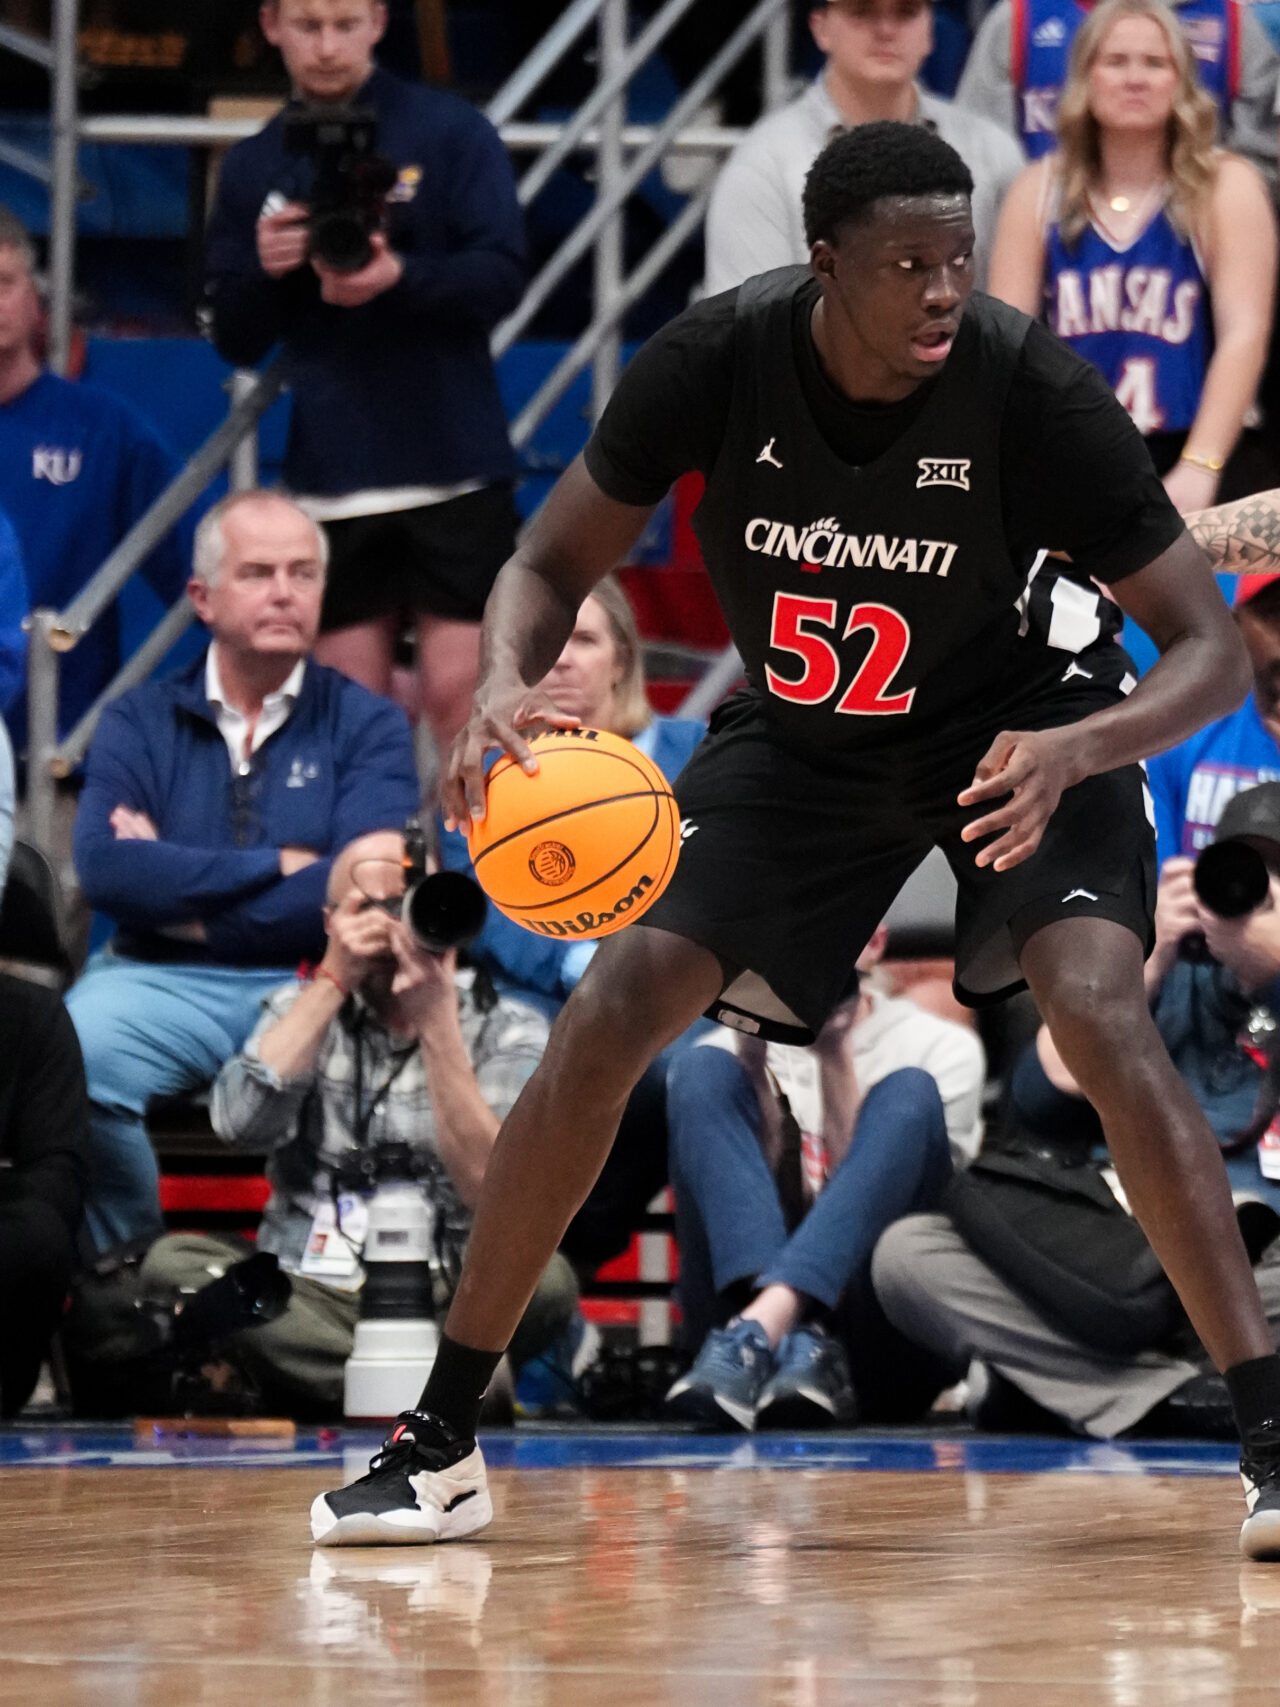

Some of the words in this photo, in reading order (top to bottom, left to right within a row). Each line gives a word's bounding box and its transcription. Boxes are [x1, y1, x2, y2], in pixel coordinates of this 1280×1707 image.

[1050, 263, 1201, 345] ANSAS
[32, 446, 83, 486] KU
[918, 460, 969, 488] XII
[744, 517, 959, 577] CINCINNATI
[764, 591, 917, 716] 52
[521, 874, 655, 936] Wilson
